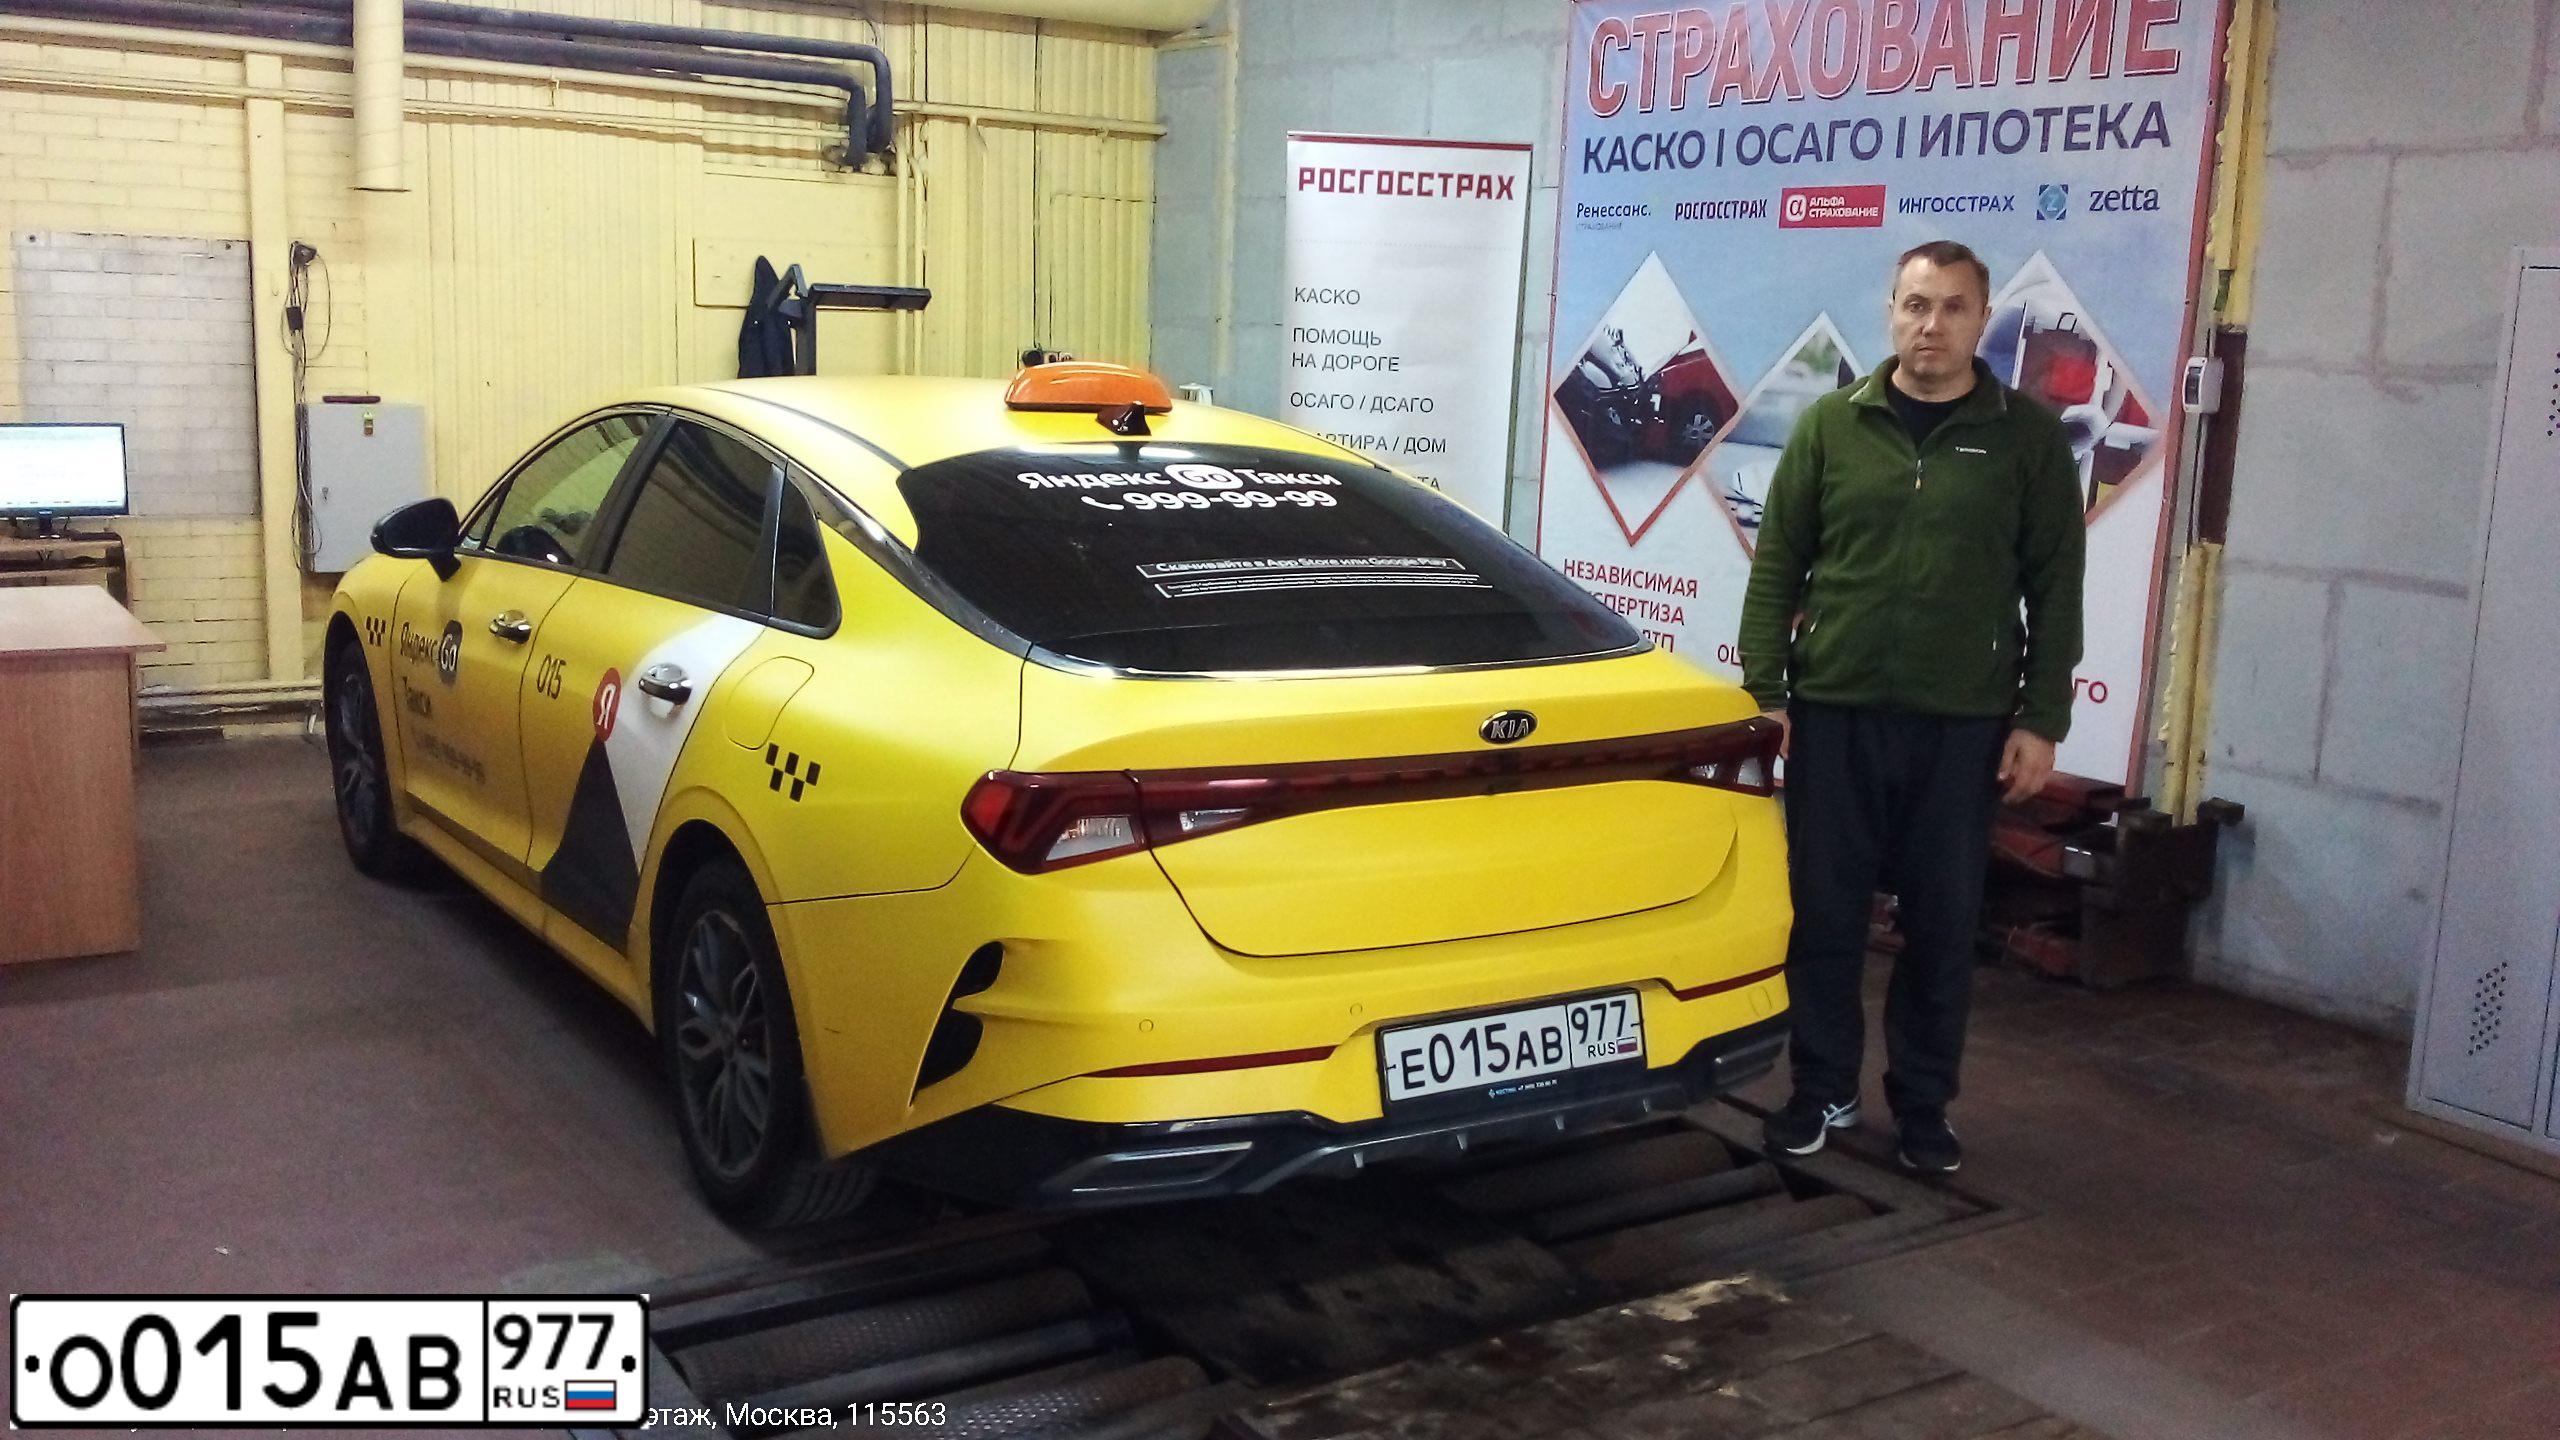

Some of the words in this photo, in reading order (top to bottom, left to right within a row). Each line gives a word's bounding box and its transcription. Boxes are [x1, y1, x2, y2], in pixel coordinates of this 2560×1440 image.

[1587, 0, 2182, 118] СТРАХОВАНИЕ
[1583, 131, 1705, 174] КАСКО
[1735, 118, 1895, 167] ОСАГО
[1918, 101, 2172, 157] ИПОТЕКА
[1298, 166, 1515, 201] РОСГОССТРАХ
[1809, 195, 1846, 207] АЛЬФА
[1898, 194, 2016, 214] ИНГОССТРАХ
[2088, 184, 2161, 212] zetta
[1674, 198, 1768, 221] РОСГОССТРАХ
[1808, 205, 1880, 219] СТРАХОВАНИЕ
[1293, 286, 1361, 305] КАСКО
[1292, 327, 1382, 348] ПОМОЩЬ
[1291, 352, 1317, 368] НА
[1322, 354, 1400, 372] ДОРОГЕ
[1290, 391, 1355, 410] ОСАГО
[1370, 395, 1434, 414] ДСАГО
[1403, 437, 1447, 455] ДОМ
[1016, 471, 1171, 490] Яндекс
[1232, 468, 1342, 486] Такси
[1122, 489, 1338, 510] 999-99-99
[1156, 560, 1253, 572] Скачивайте
[1267, 558, 1298, 569] App
[1298, 557, 1340, 567] Store
[1340, 557, 1369, 566] или
[1563, 558, 1698, 599] НЕЗАВИСИМАЯ
[401, 621, 439, 664] Яндекс
[440, 633, 458, 672] Go
[536, 653, 567, 700] 015
[1491, 718, 1529, 739] KIA
[1570, 999, 1627, 1045] 977
[1587, 1041, 1616, 1059] RUS
